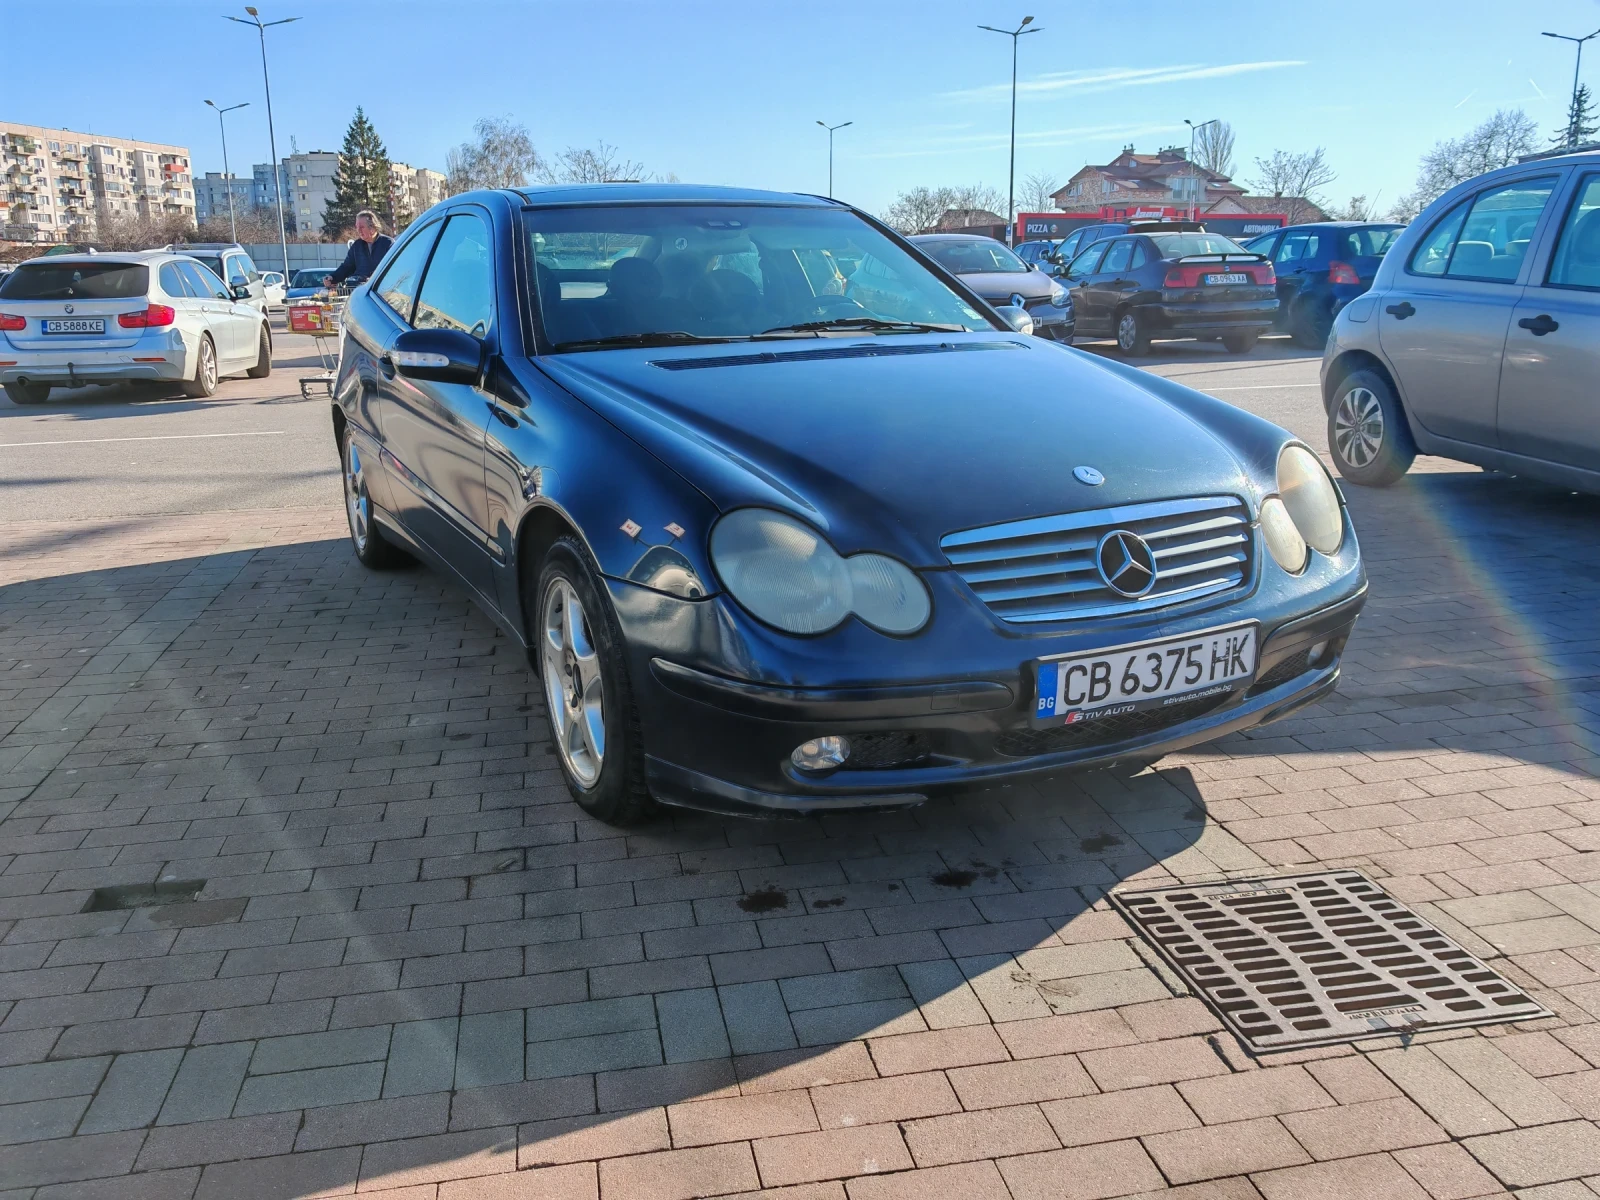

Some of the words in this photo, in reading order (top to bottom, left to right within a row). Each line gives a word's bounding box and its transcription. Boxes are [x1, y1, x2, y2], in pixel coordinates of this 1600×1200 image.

[1027, 224, 1049, 233] PIZZA
[49, 321, 62, 331] CB
[63, 321, 88, 331] 5888
[89, 321, 103, 331] KE
[1063, 661, 1112, 706] CB
[1120, 644, 1203, 695] 6375
[1209, 632, 1251, 681] HK
[1163, 684, 1233, 705] stivauto.mobile.bg
[1038, 697, 1054, 710] BG
[1104, 704, 1136, 716] AUTO
